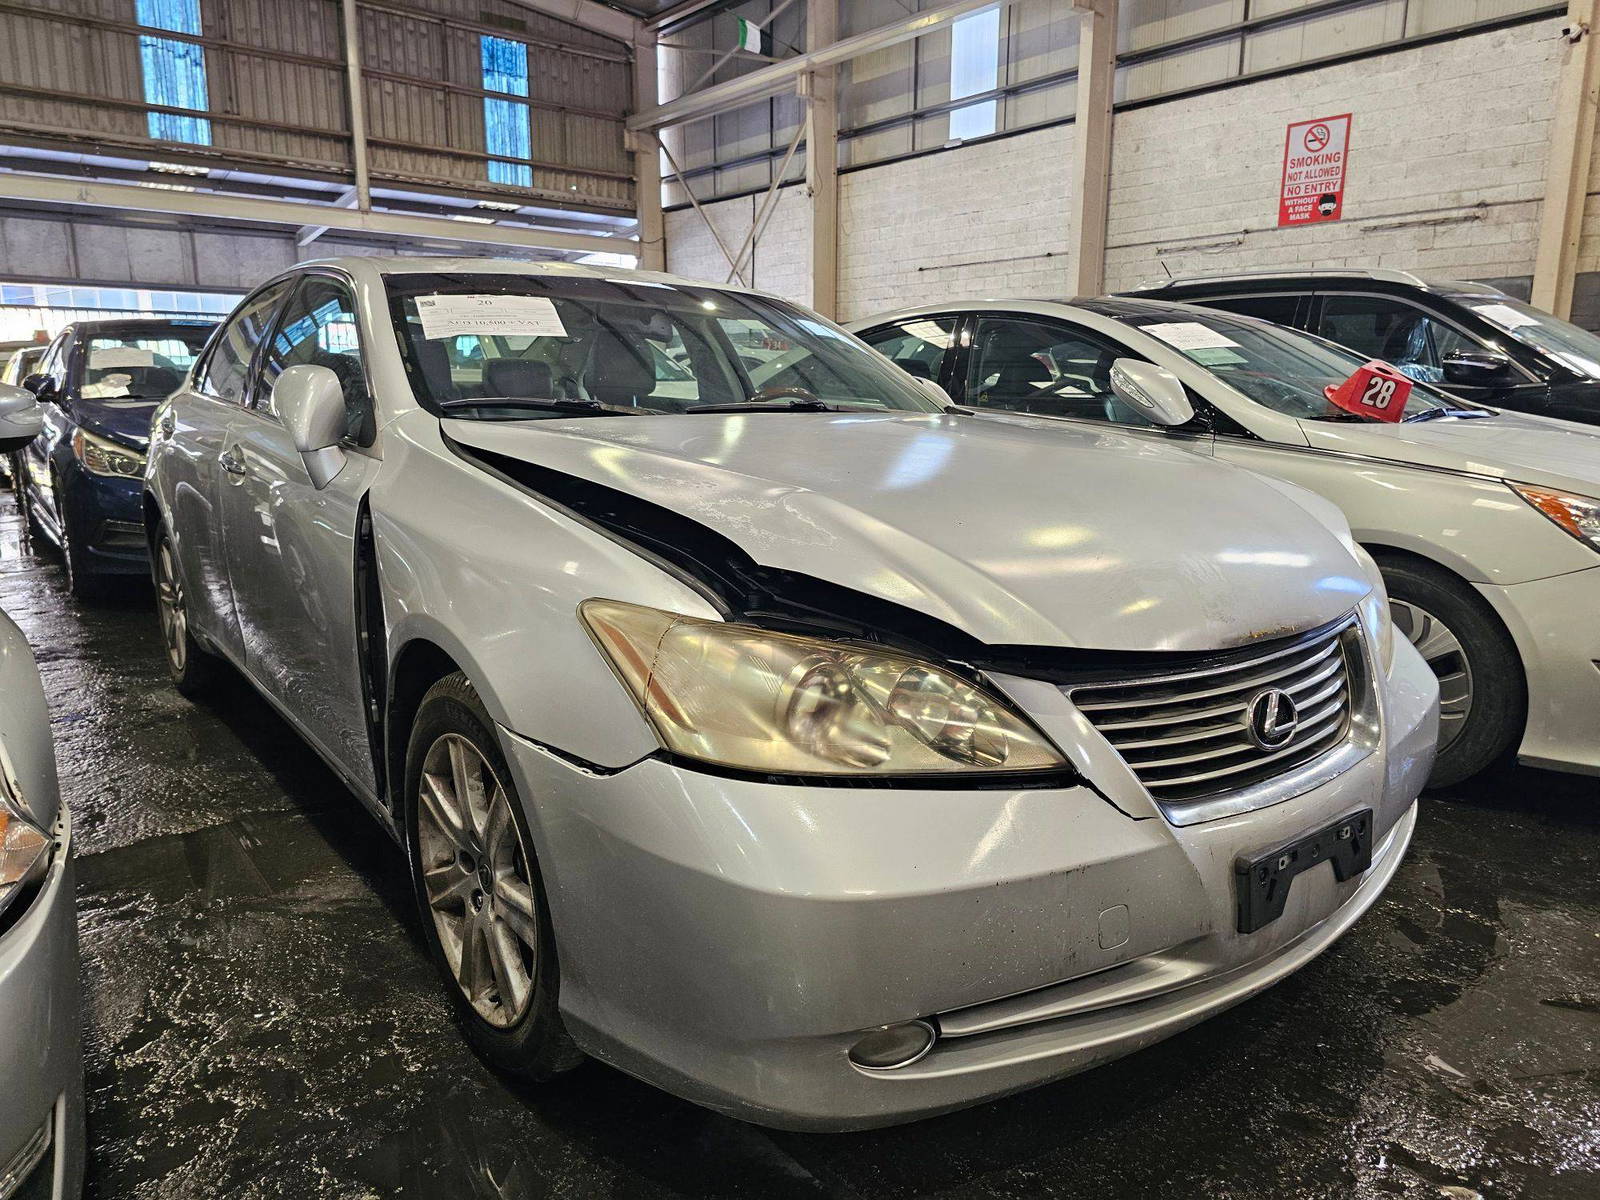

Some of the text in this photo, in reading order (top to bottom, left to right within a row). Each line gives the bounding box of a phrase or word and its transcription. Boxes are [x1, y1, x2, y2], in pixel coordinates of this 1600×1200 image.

[1289, 152, 1341, 169] SMOKING
[1287, 166, 1340, 182] NOT ALLOWED
[1287, 181, 1338, 196] NO ENTRY
[1285, 196, 1318, 206] WITHOUT
[1295, 204, 1313, 212] FACE
[1361, 376, 1396, 409] 28
